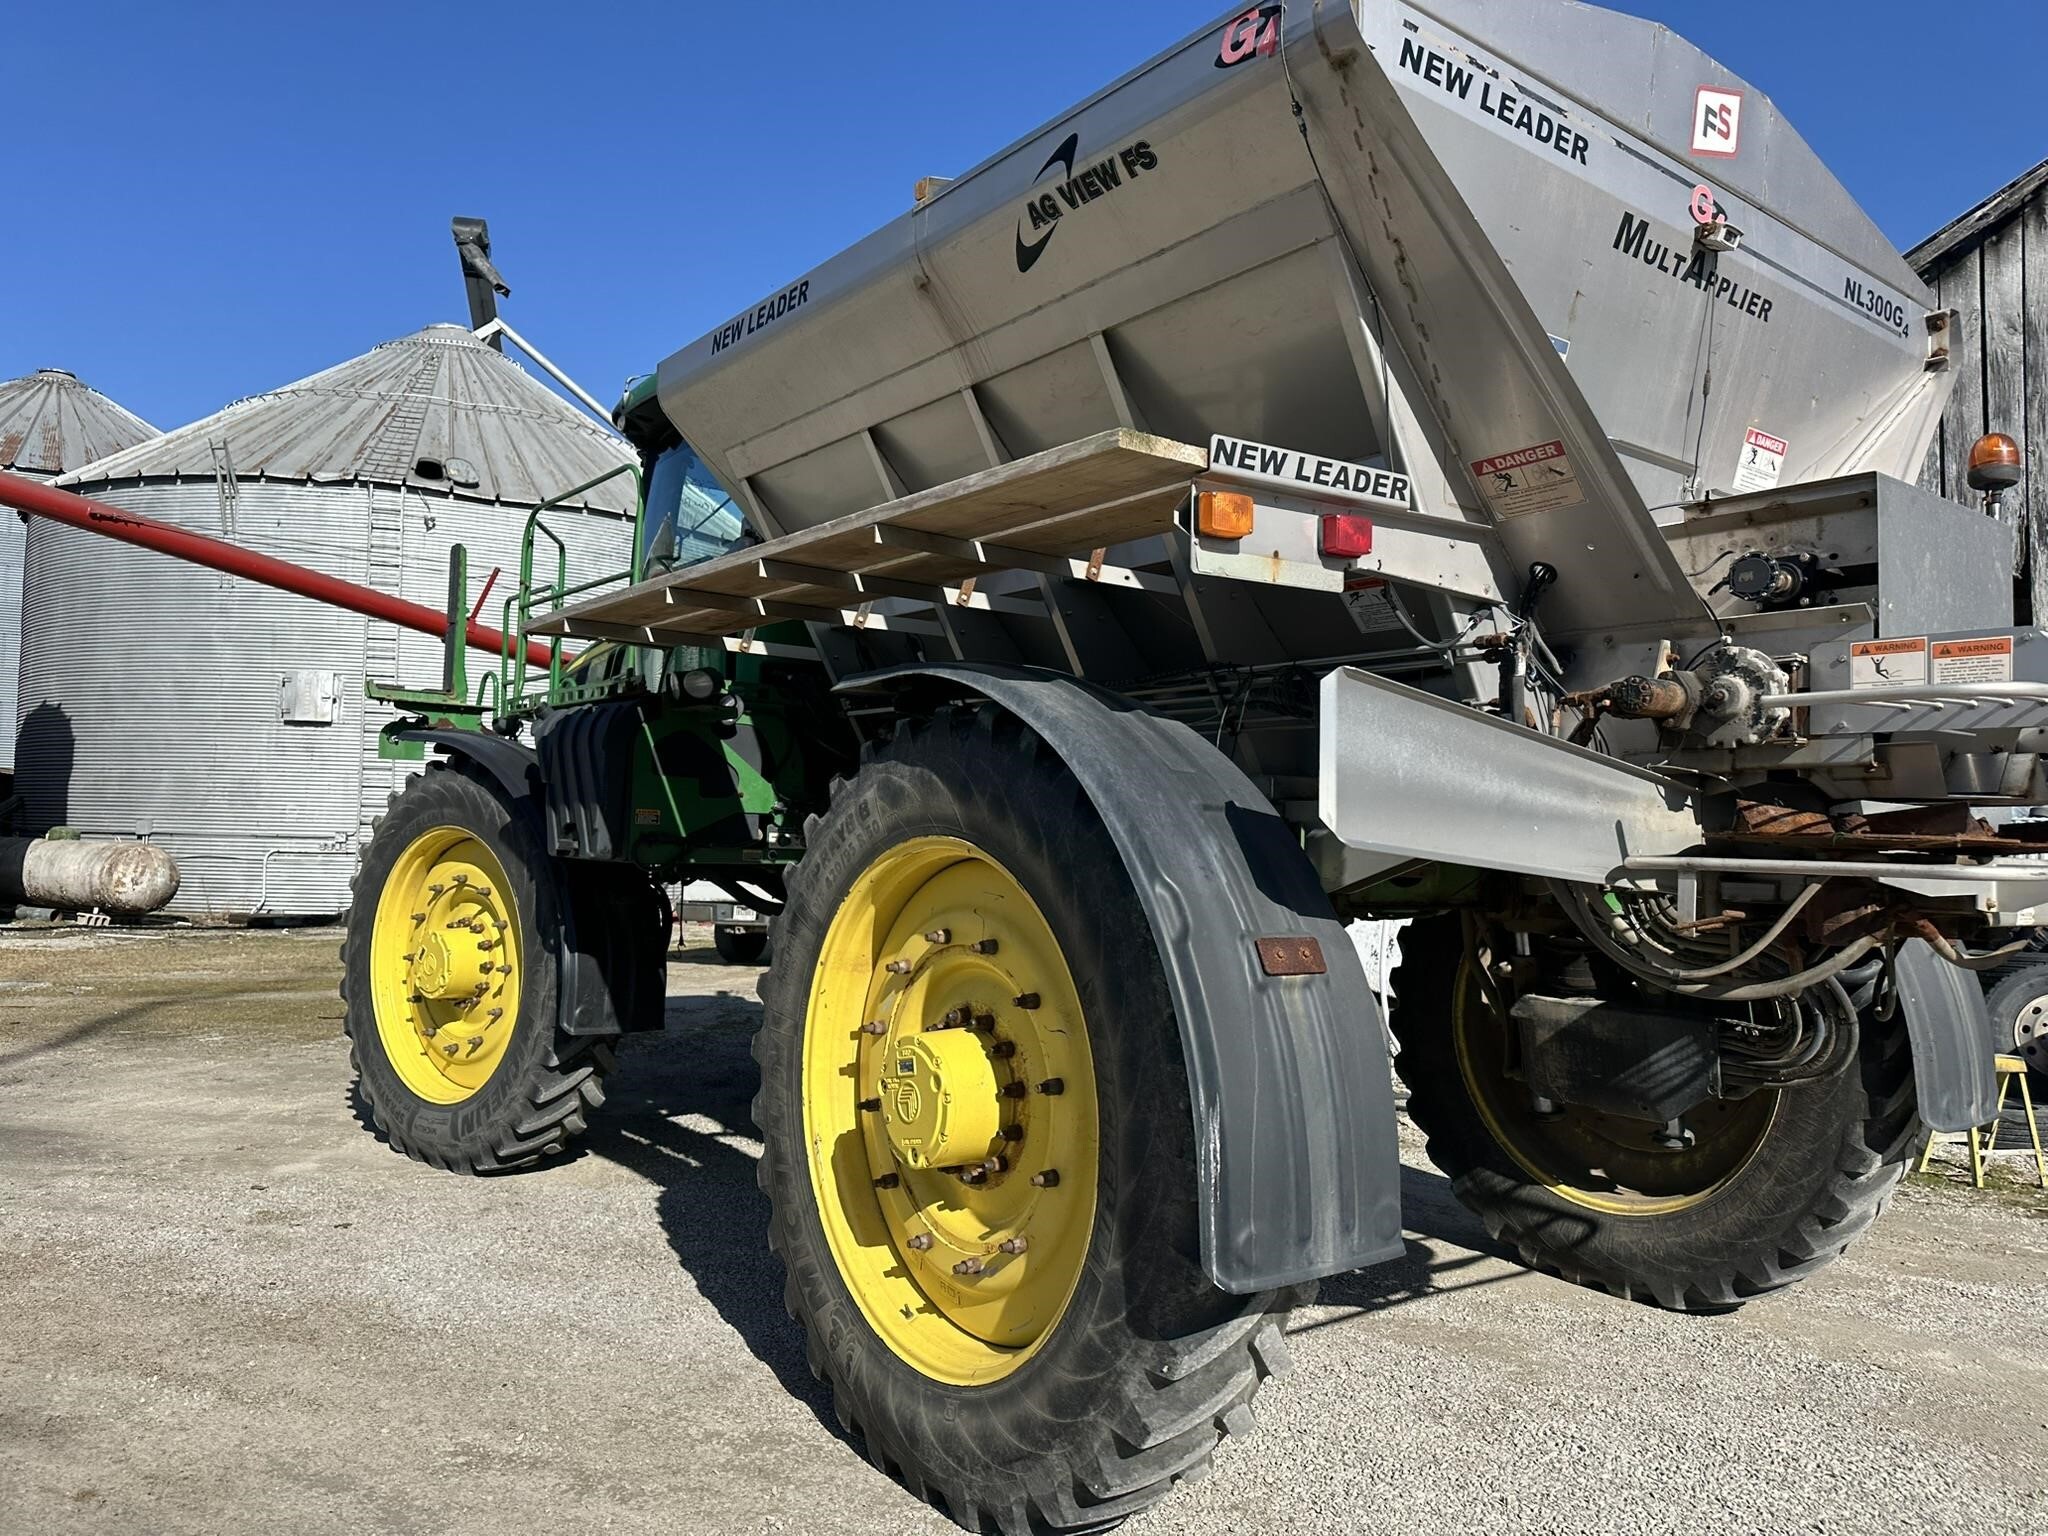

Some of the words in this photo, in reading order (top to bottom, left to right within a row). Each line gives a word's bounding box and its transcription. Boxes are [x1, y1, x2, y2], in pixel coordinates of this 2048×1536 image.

[1399, 38, 1473, 99] NEW
[1479, 82, 1589, 166] LEADER
[1702, 103, 1731, 140] FS
[1026, 194, 1063, 230] AG
[1055, 157, 1121, 211] VIEW
[1122, 140, 1158, 180] FS
[712, 318, 744, 355] NEW
[747, 280, 809, 334] LEADER
[1495, 444, 1558, 468] DANGER
[1757, 433, 1782, 453] DANGER
[1213, 439, 1288, 476] NEW
[1296, 457, 1408, 501] LEADER
[1874, 642, 1917, 652] WARNING
[1957, 643, 2004, 653] WARNING
